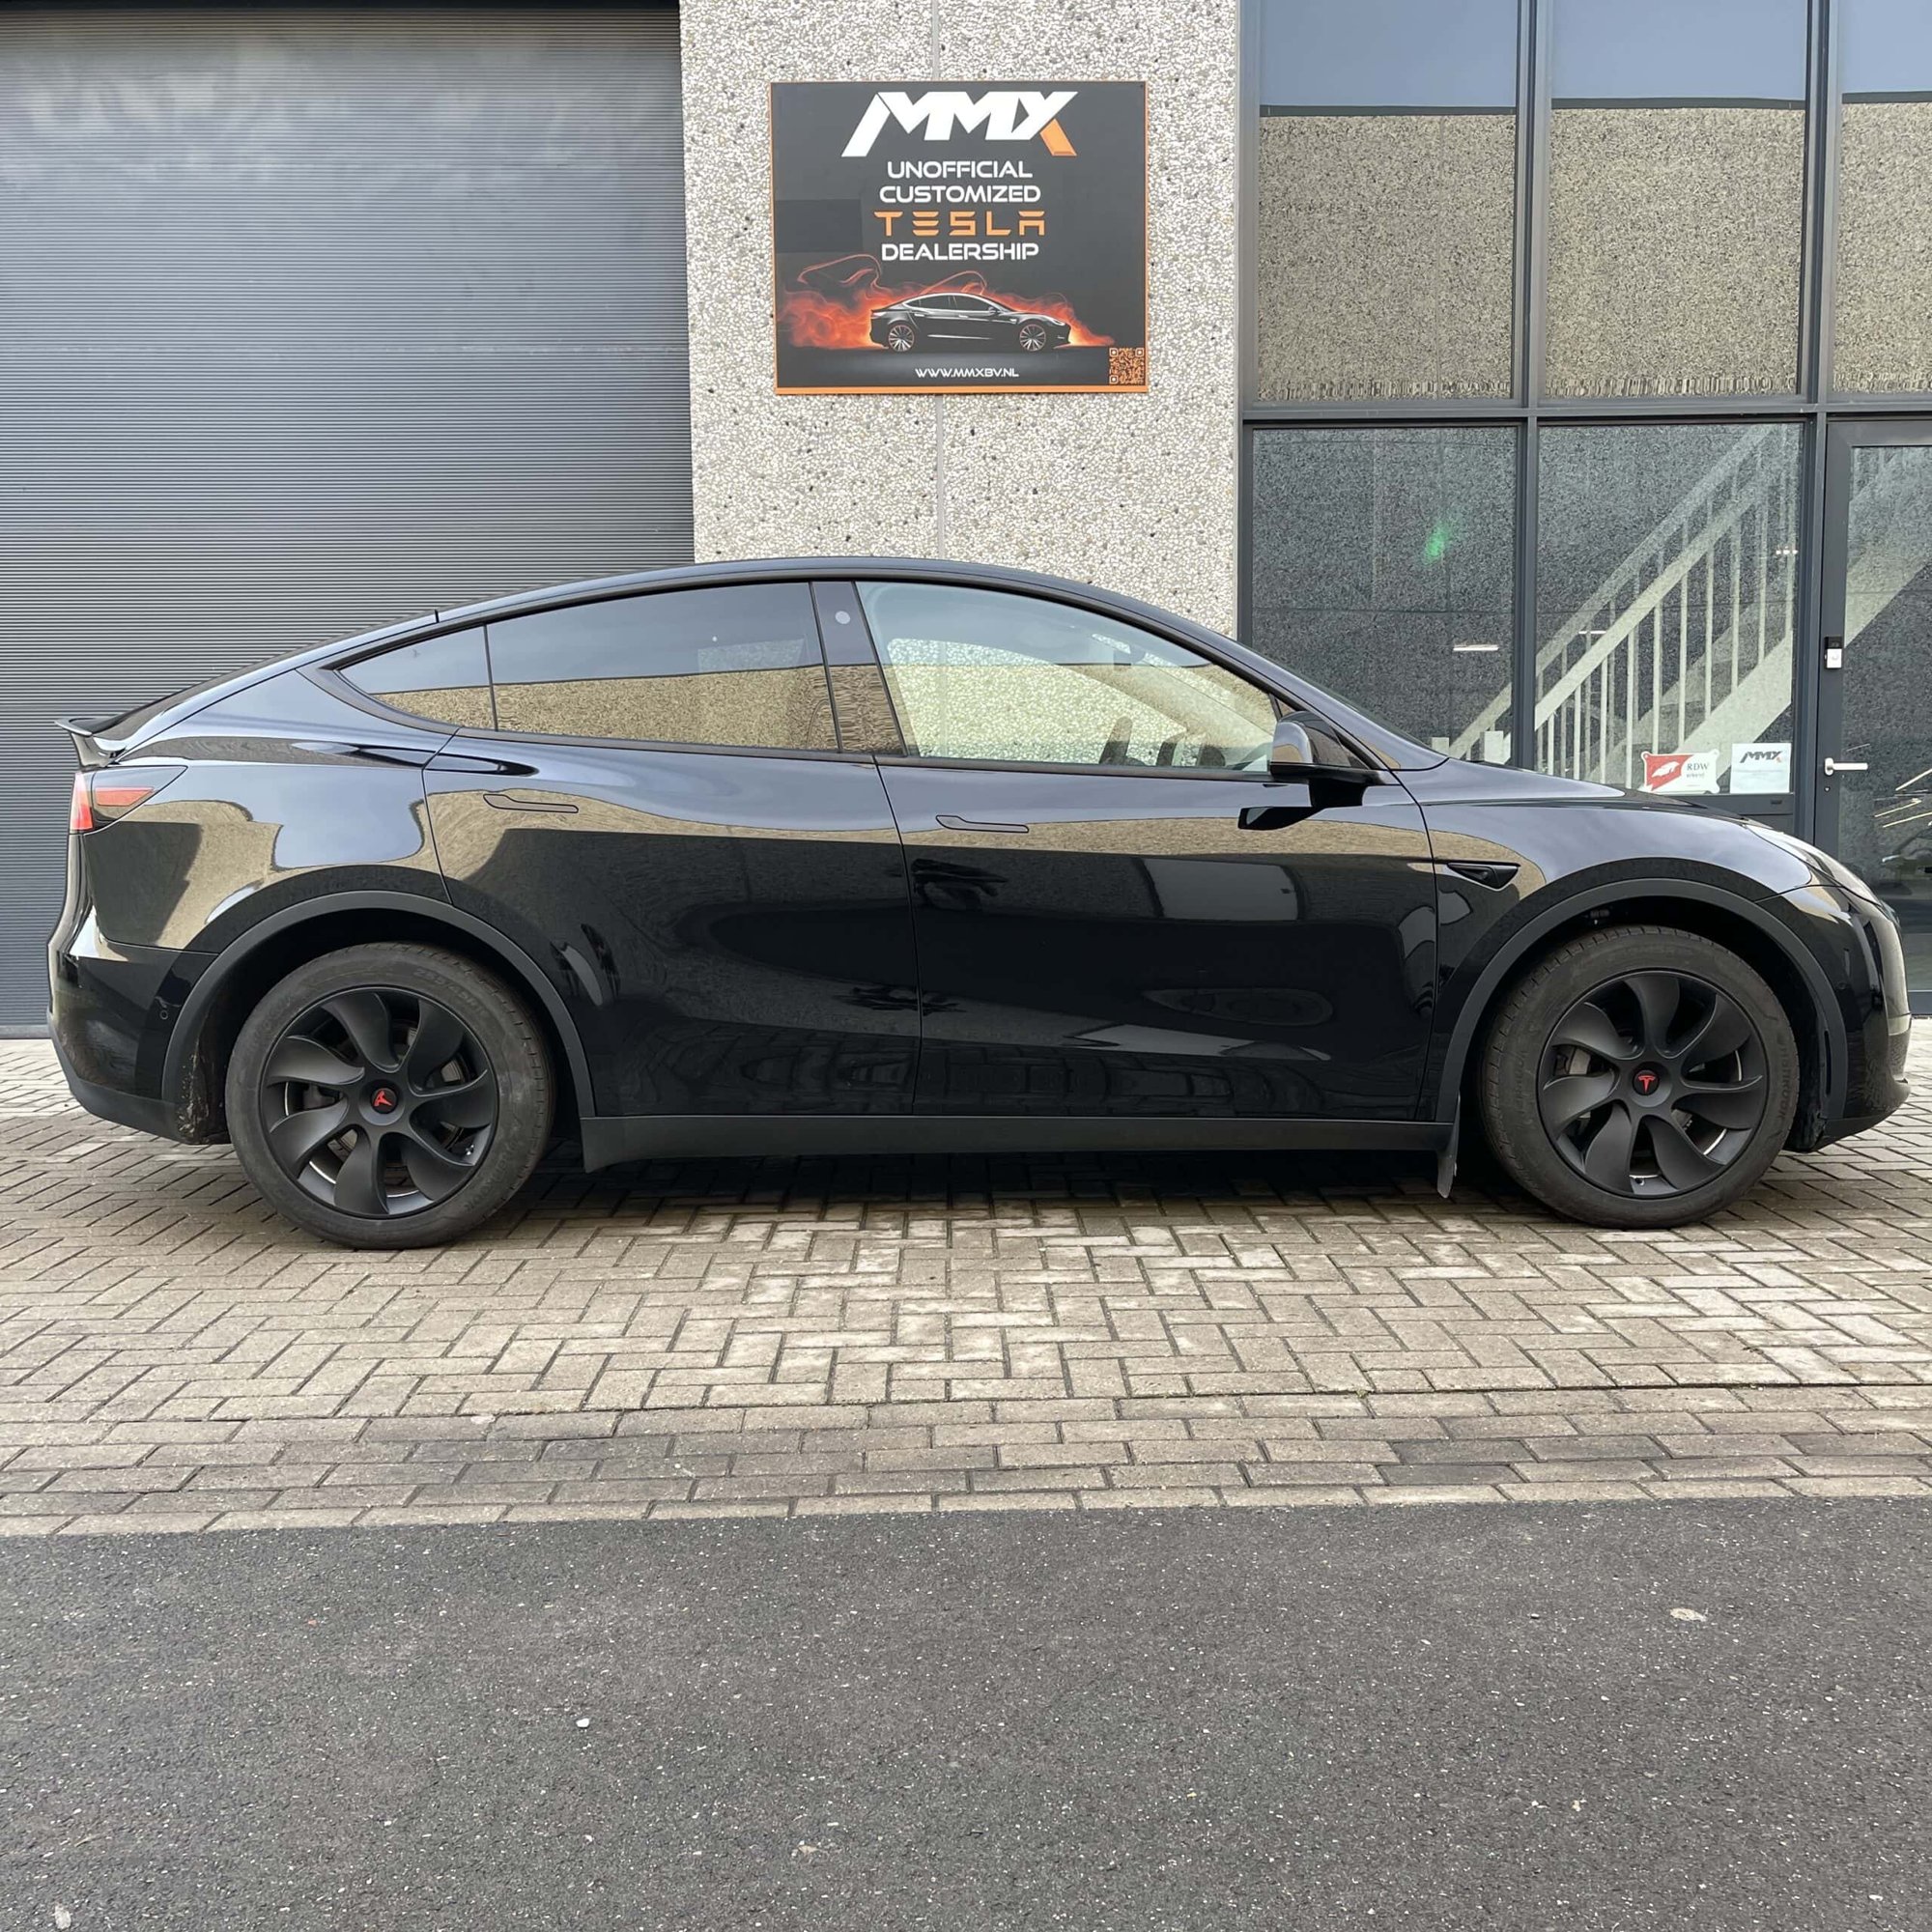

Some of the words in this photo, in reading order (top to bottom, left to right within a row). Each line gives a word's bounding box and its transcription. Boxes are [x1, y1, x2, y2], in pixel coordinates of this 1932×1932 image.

[840, 91, 1078, 157] MMX
[887, 160, 1034, 180] UNOFFICIAL
[879, 185, 1041, 204] CUSTOMIZED
[874, 210, 1046, 237] TESLA
[881, 242, 1039, 262] DEALERSHIP
[915, 367, 1020, 379] WWW.MMXBV.NL
[1687, 762, 1709, 771] RDW
